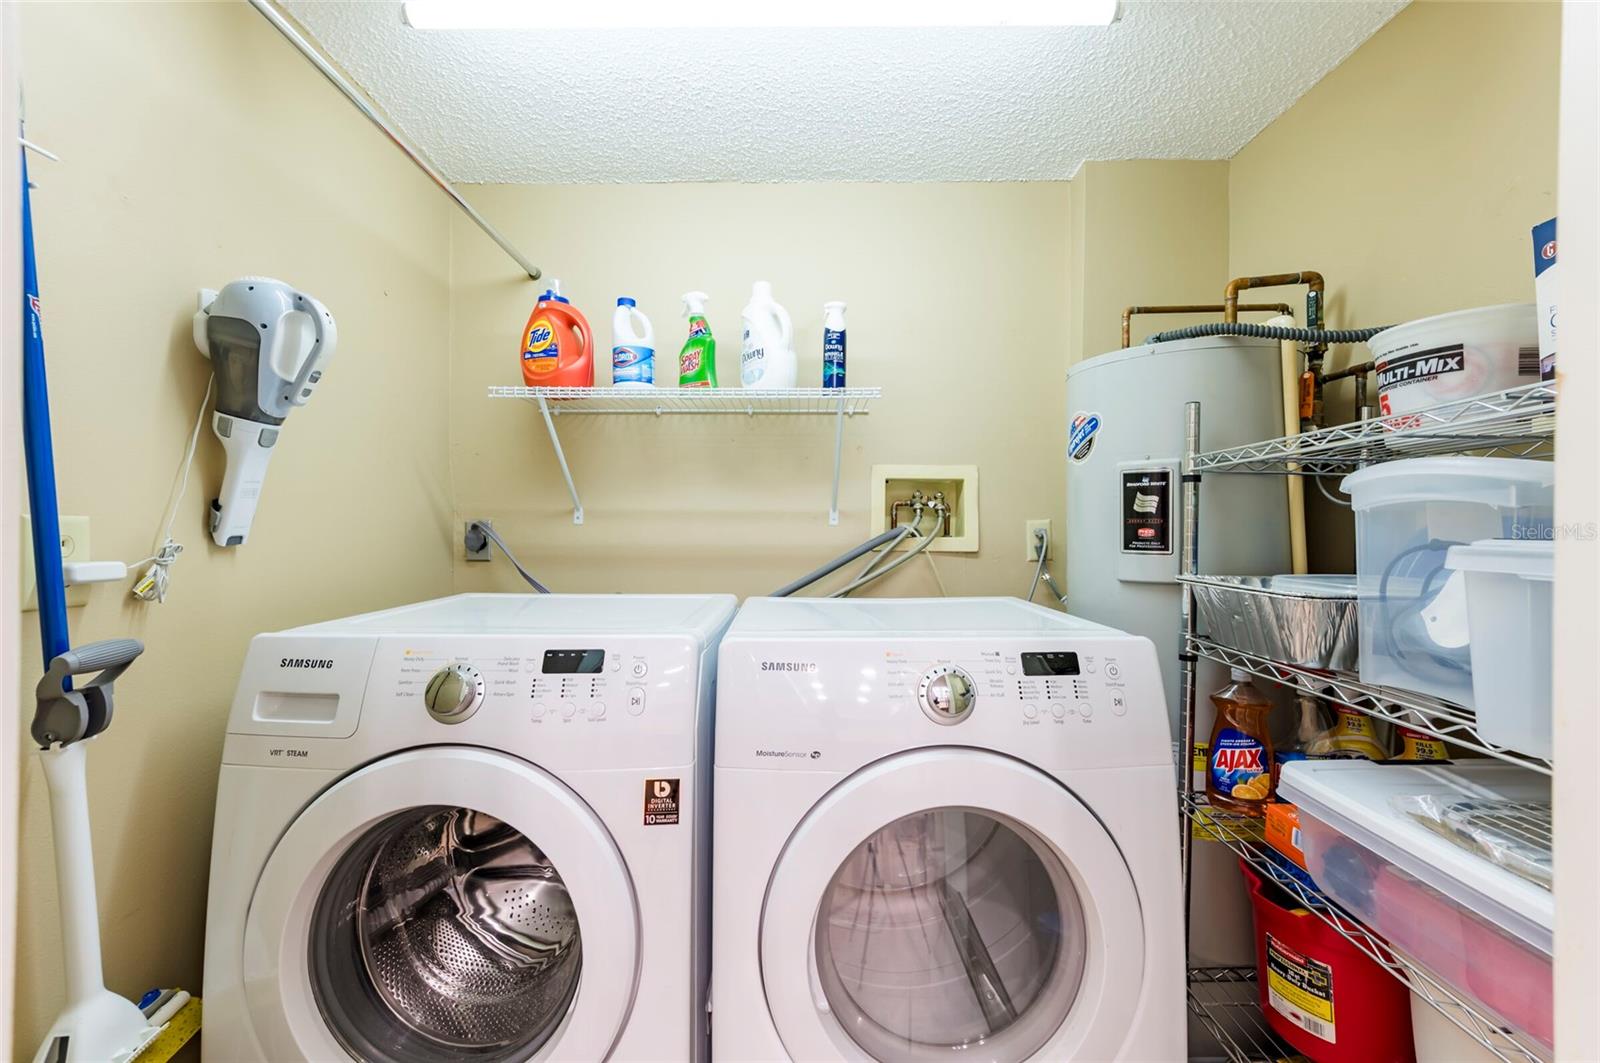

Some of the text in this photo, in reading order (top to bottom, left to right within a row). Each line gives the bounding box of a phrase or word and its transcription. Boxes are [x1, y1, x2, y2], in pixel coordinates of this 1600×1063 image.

[529, 328, 551, 348] Tide
[681, 348, 702, 366] SPRAY
[742, 347, 764, 363] Downy
[1377, 355, 1462, 387] MULTI-MIX
[1399, 375, 1439, 388] CONTAINER
[280, 658, 334, 669] SAMSUNG
[761, 662, 817, 672] SAMSUNG
[287, 750, 308, 758] STEAM
[756, 750, 807, 758] MoistureSensor
[1215, 749, 1262, 772] AJAX
[645, 814, 656, 824] 10
[1302, 982, 1326, 997] Bucket
